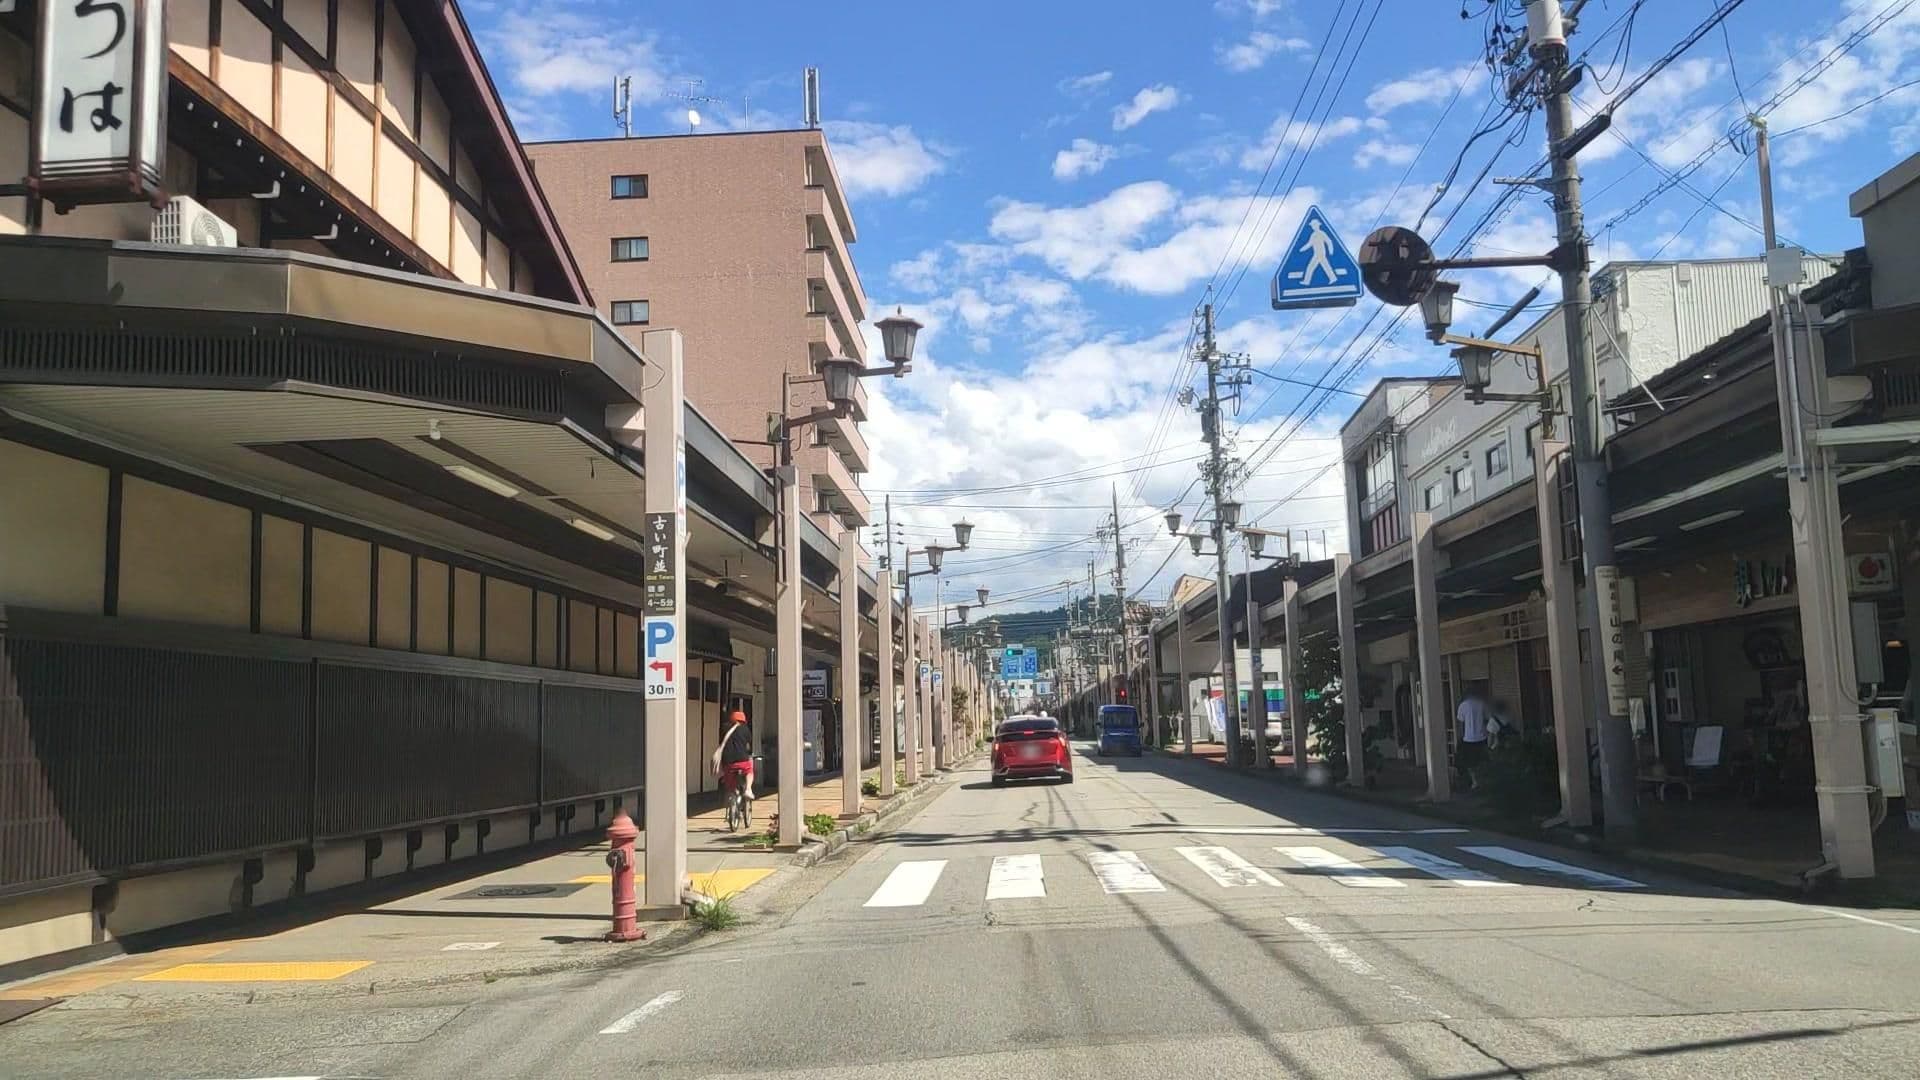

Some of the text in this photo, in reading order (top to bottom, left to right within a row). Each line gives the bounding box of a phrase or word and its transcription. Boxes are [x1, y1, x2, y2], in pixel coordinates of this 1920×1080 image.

[652, 515, 669, 573] 古い町並
[647, 622, 675, 658] P
[921, 667, 929, 677] P
[934, 674, 941, 683] P
